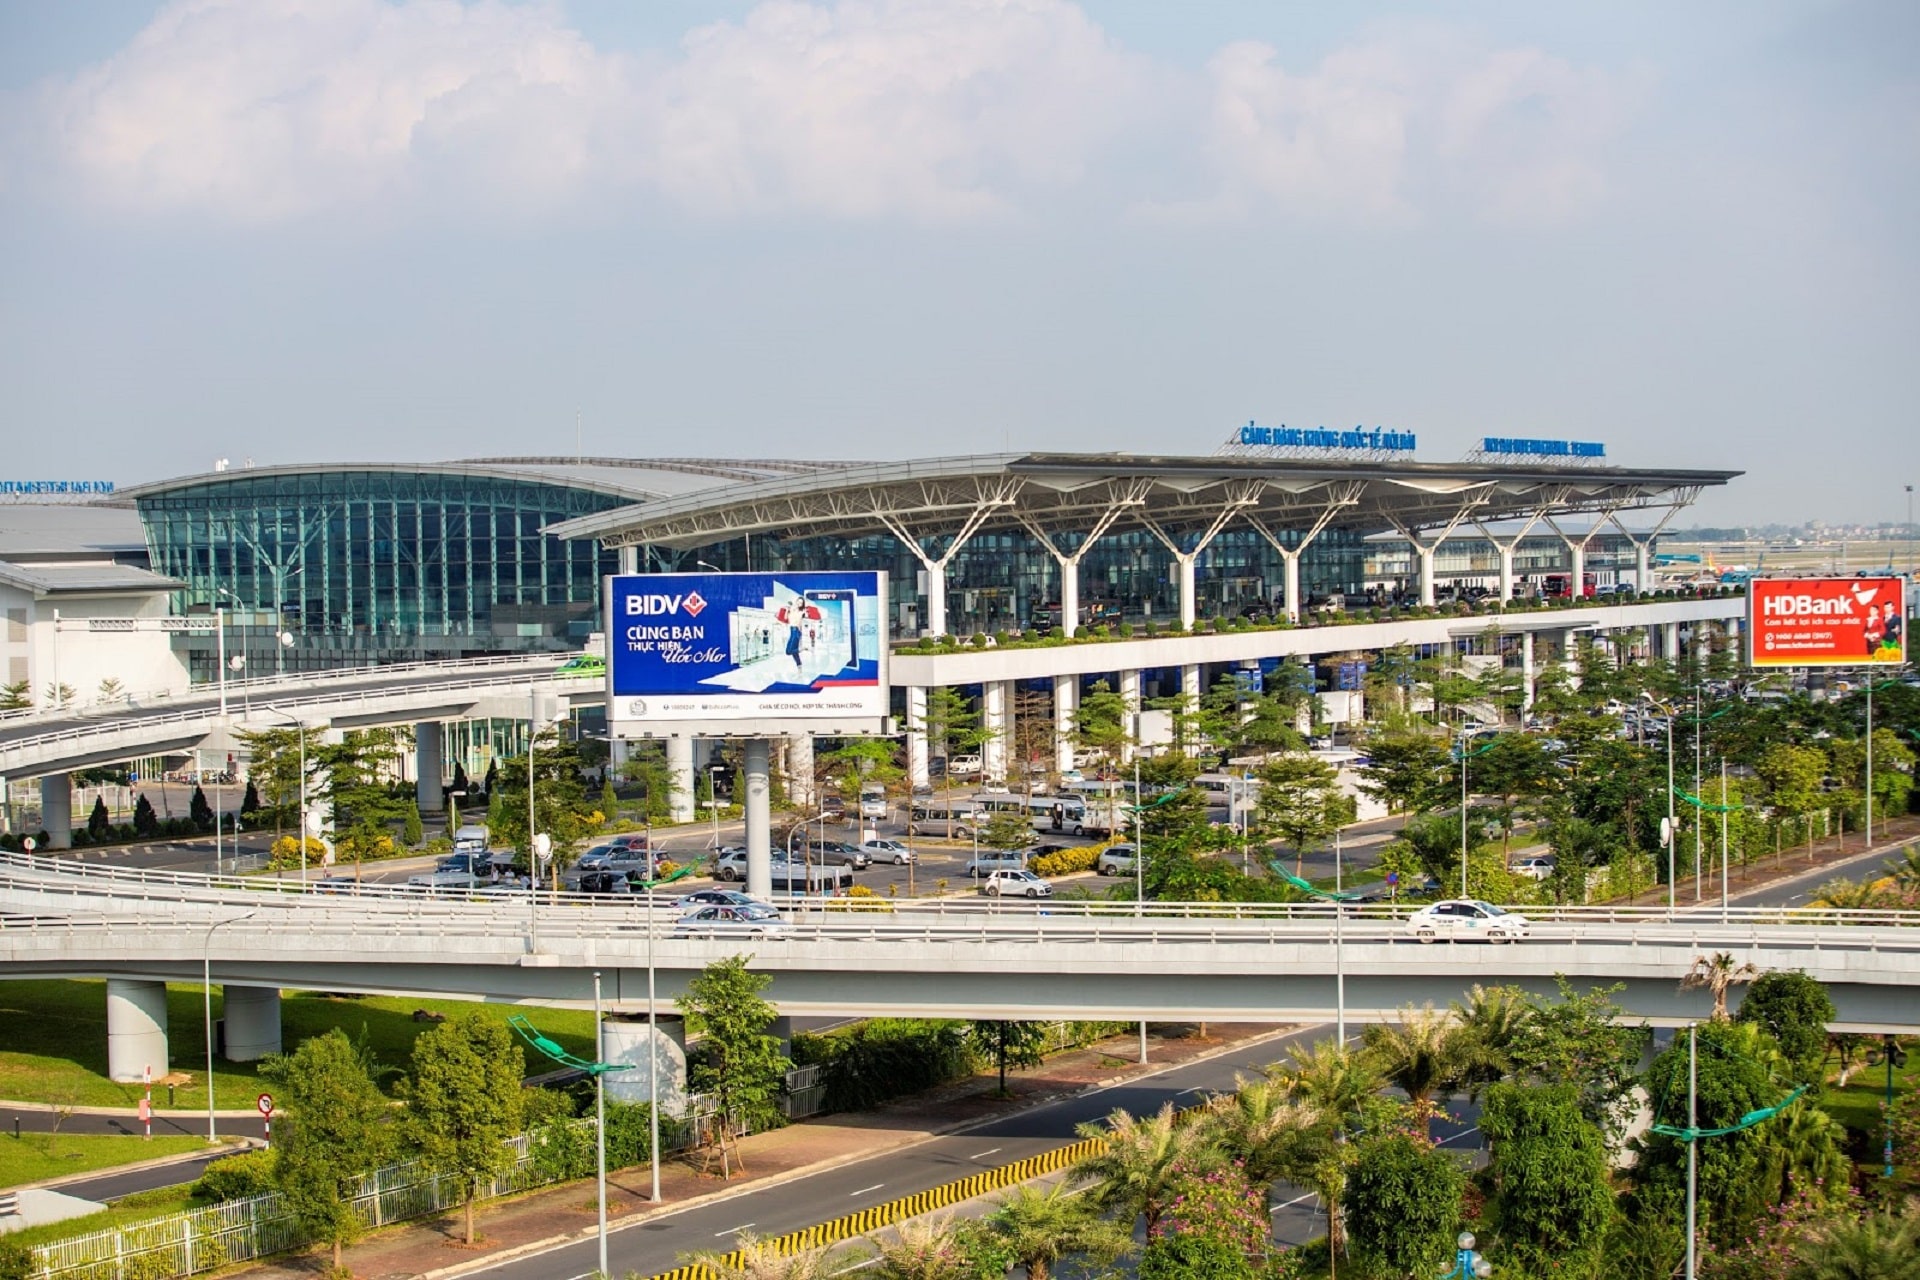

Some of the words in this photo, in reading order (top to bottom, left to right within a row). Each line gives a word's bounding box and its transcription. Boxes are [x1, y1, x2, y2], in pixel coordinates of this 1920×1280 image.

[626, 594, 682, 615] BIDV
[1764, 595, 1854, 616] HDBank
[627, 625, 669, 640] CÙNG
[672, 626, 704, 641] BẠN
[627, 641, 654, 653] THỰC
